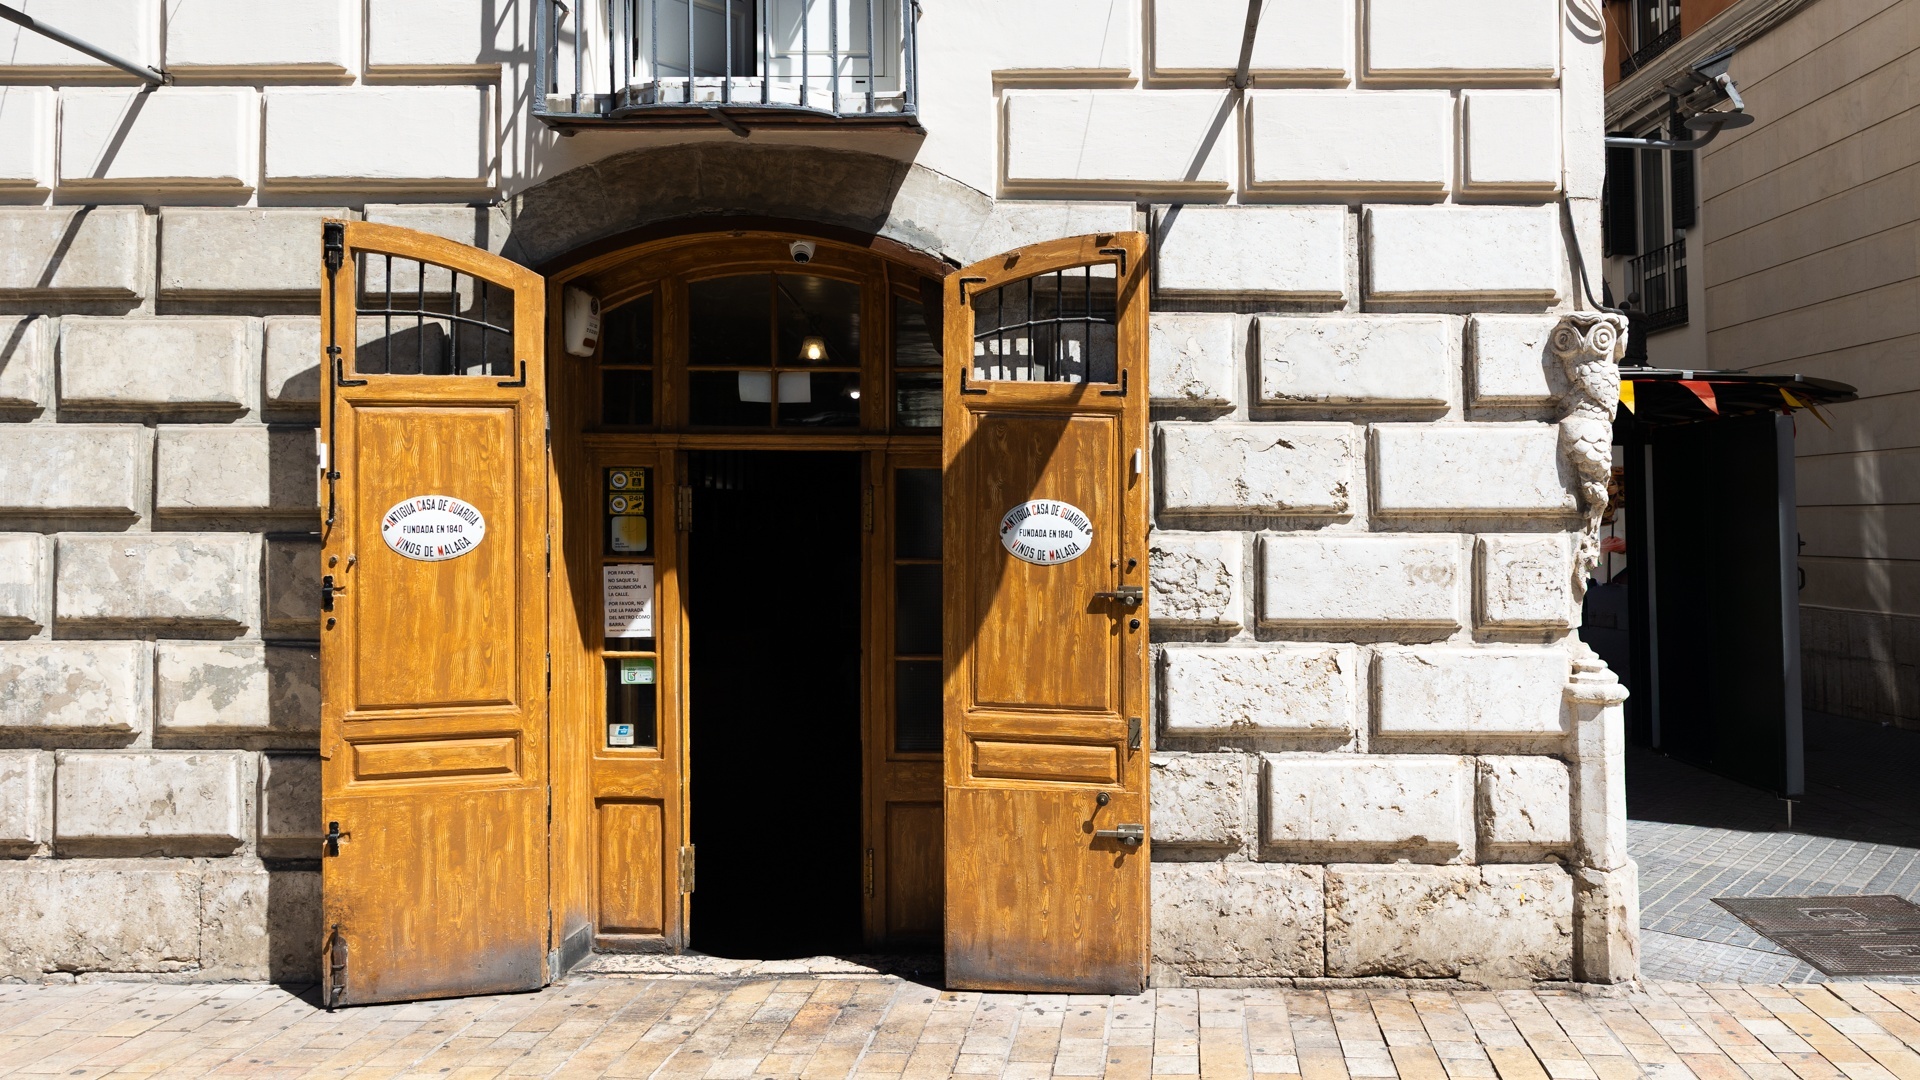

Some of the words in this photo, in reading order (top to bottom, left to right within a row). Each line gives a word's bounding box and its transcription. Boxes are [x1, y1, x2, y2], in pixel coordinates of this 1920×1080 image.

[386, 503, 416, 527] ANTIGUA
[416, 499, 436, 511] CASA
[437, 499, 448, 511] DE
[448, 502, 480, 526] GUARDIA
[1004, 507, 1031, 530] ANTIGUA
[1031, 503, 1049, 515] CASA
[1051, 504, 1060, 516] DE
[1060, 507, 1088, 532] GUARDIA
[403, 525, 434, 533] FUNDADA
[436, 525, 445, 533] EN
[446, 525, 463, 533] 1840
[1019, 528, 1047, 538] FUNDADA
[1049, 530, 1057, 538] EN
[1058, 530, 1073, 538] 1840
[395, 537, 421, 556] VINOS
[424, 546, 434, 557] DE
[437, 536, 472, 556] MALAGA
[1012, 539, 1035, 559] VINOS
[1037, 549, 1046, 561] DE
[1049, 542, 1081, 561] MALAGA
